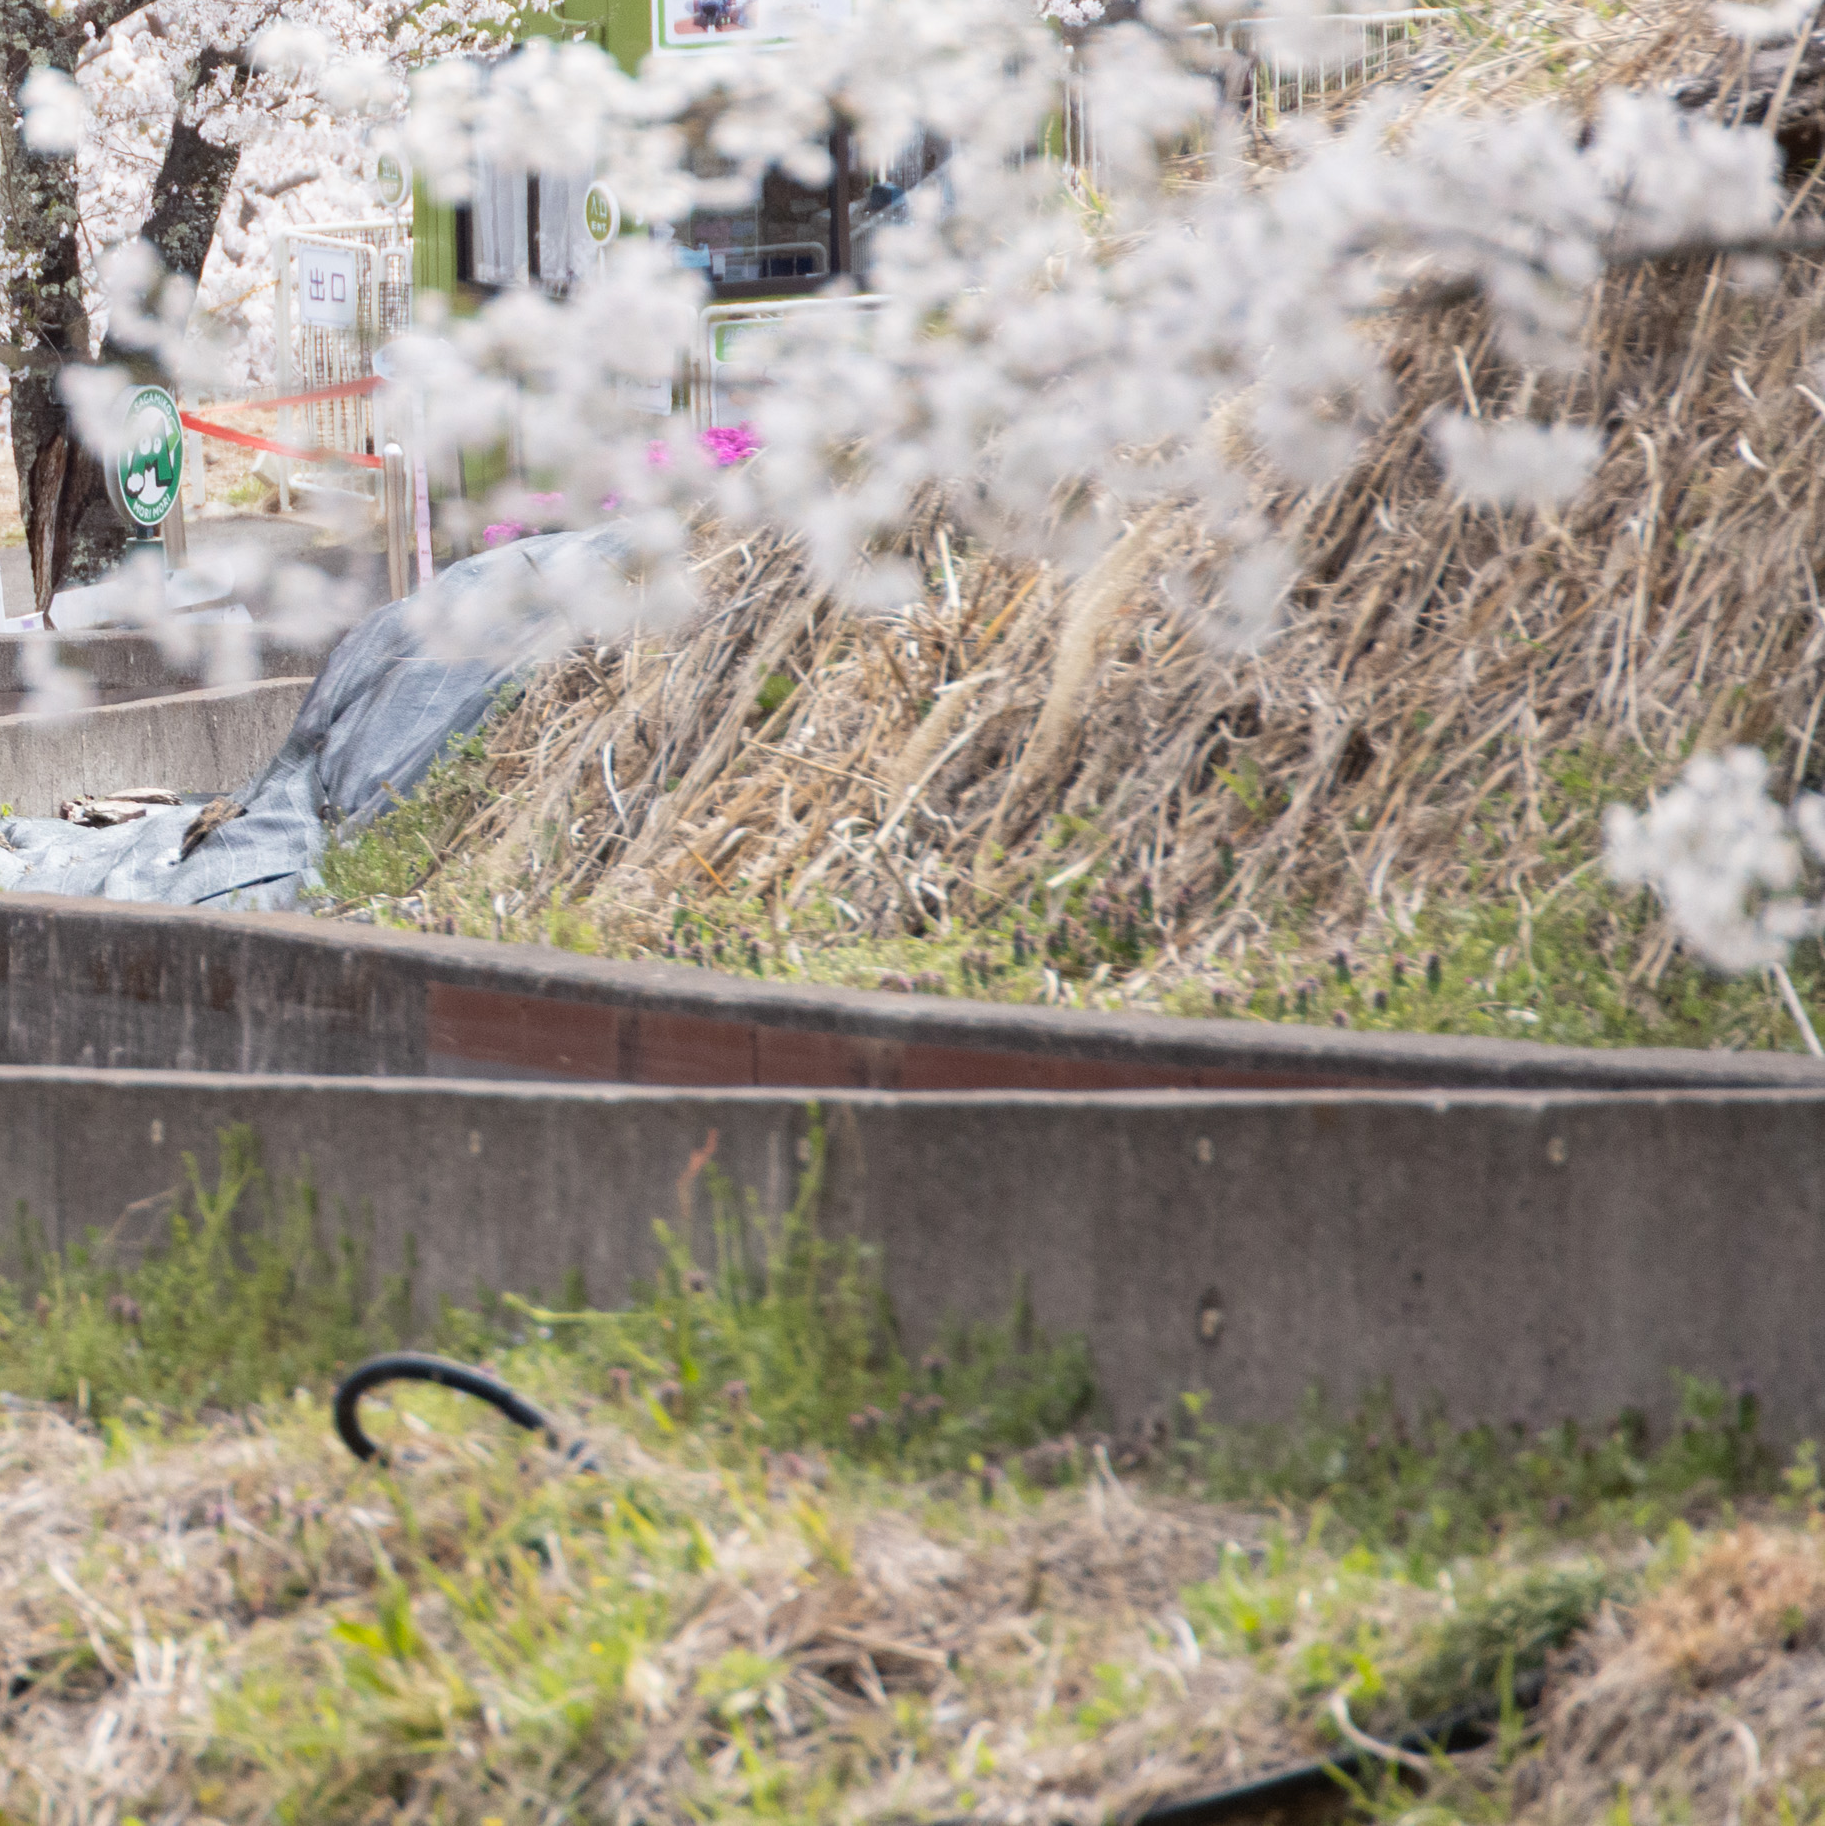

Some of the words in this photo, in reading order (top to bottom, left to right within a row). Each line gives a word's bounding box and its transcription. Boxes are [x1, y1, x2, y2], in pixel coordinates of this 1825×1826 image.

[590, 195, 607, 218] 入口
[309, 267, 345, 302] 出口
[133, 392, 172, 416] SAGAMIKO
[133, 500, 152, 519] MORI
[152, 493, 171, 518] MORI
